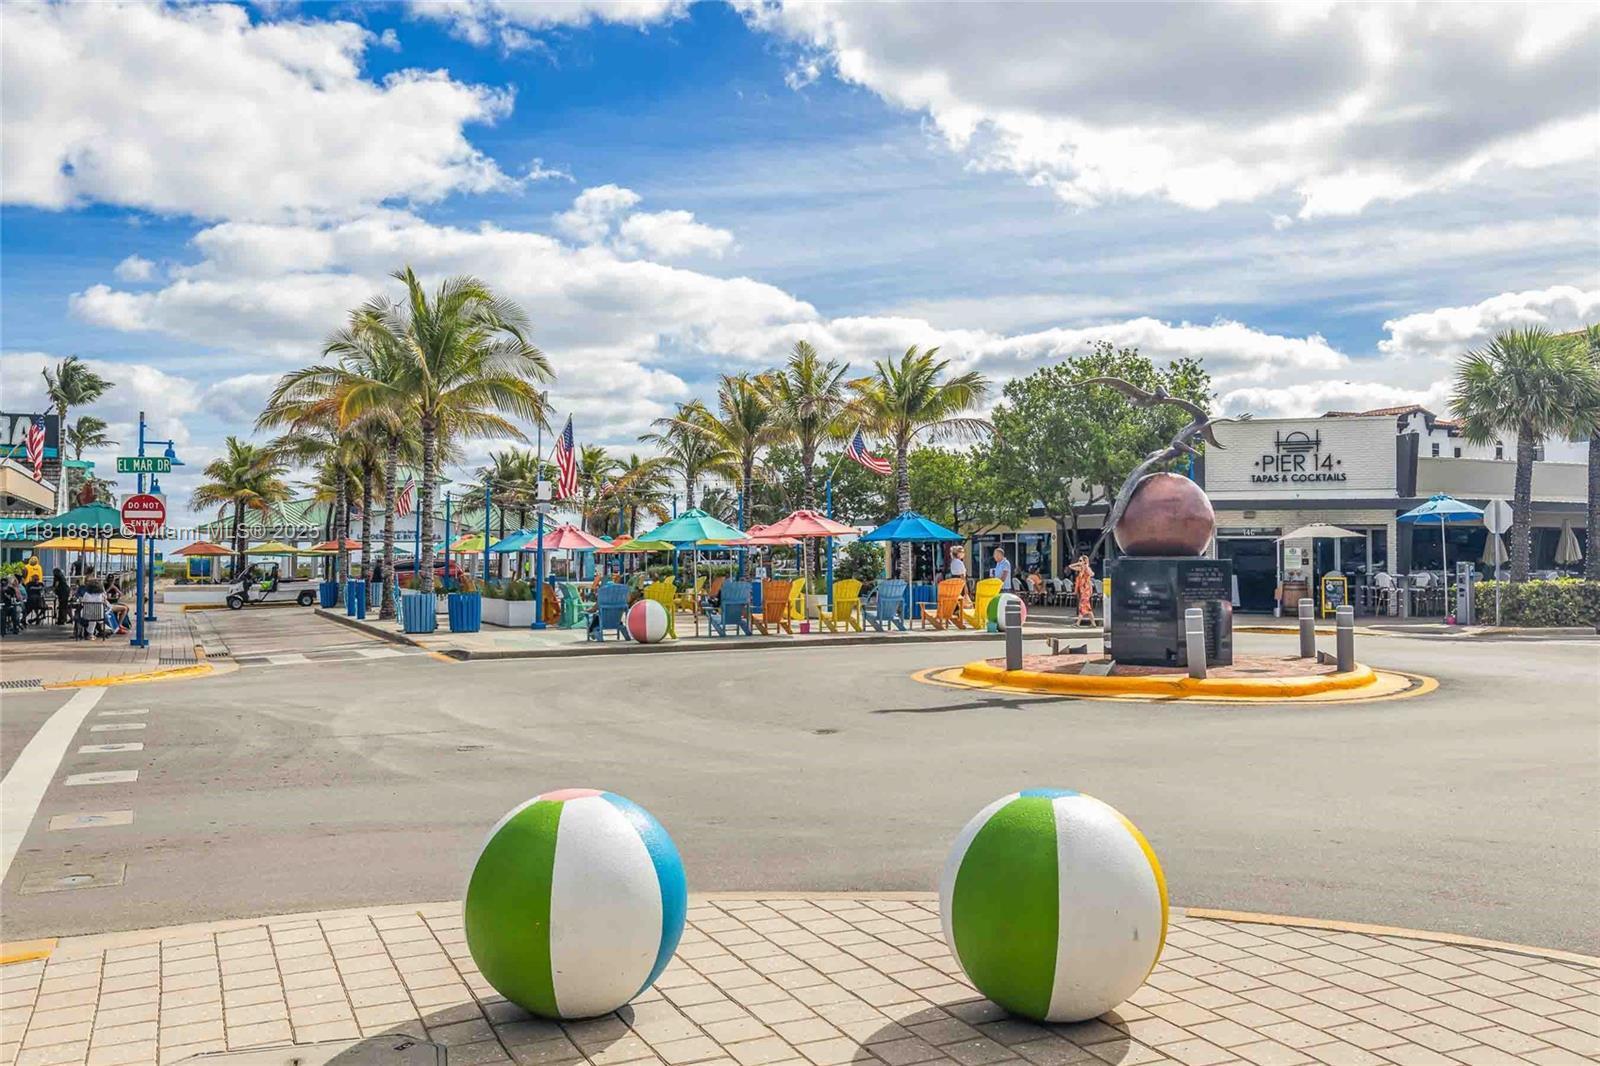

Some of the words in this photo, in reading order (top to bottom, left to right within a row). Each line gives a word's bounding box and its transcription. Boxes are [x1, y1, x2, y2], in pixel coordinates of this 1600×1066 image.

[118, 459, 129, 471] EL
[133, 459, 153, 471] MAR
[157, 459, 170, 471] DR
[1262, 454, 1306, 472] PIER
[1313, 453, 1333, 471] 14
[1251, 474, 1279, 483] TAPAS
[1282, 474, 1288, 482] &
[1290, 473, 1347, 482] COCKTAILS
[130, 519, 156, 527] ENTER
